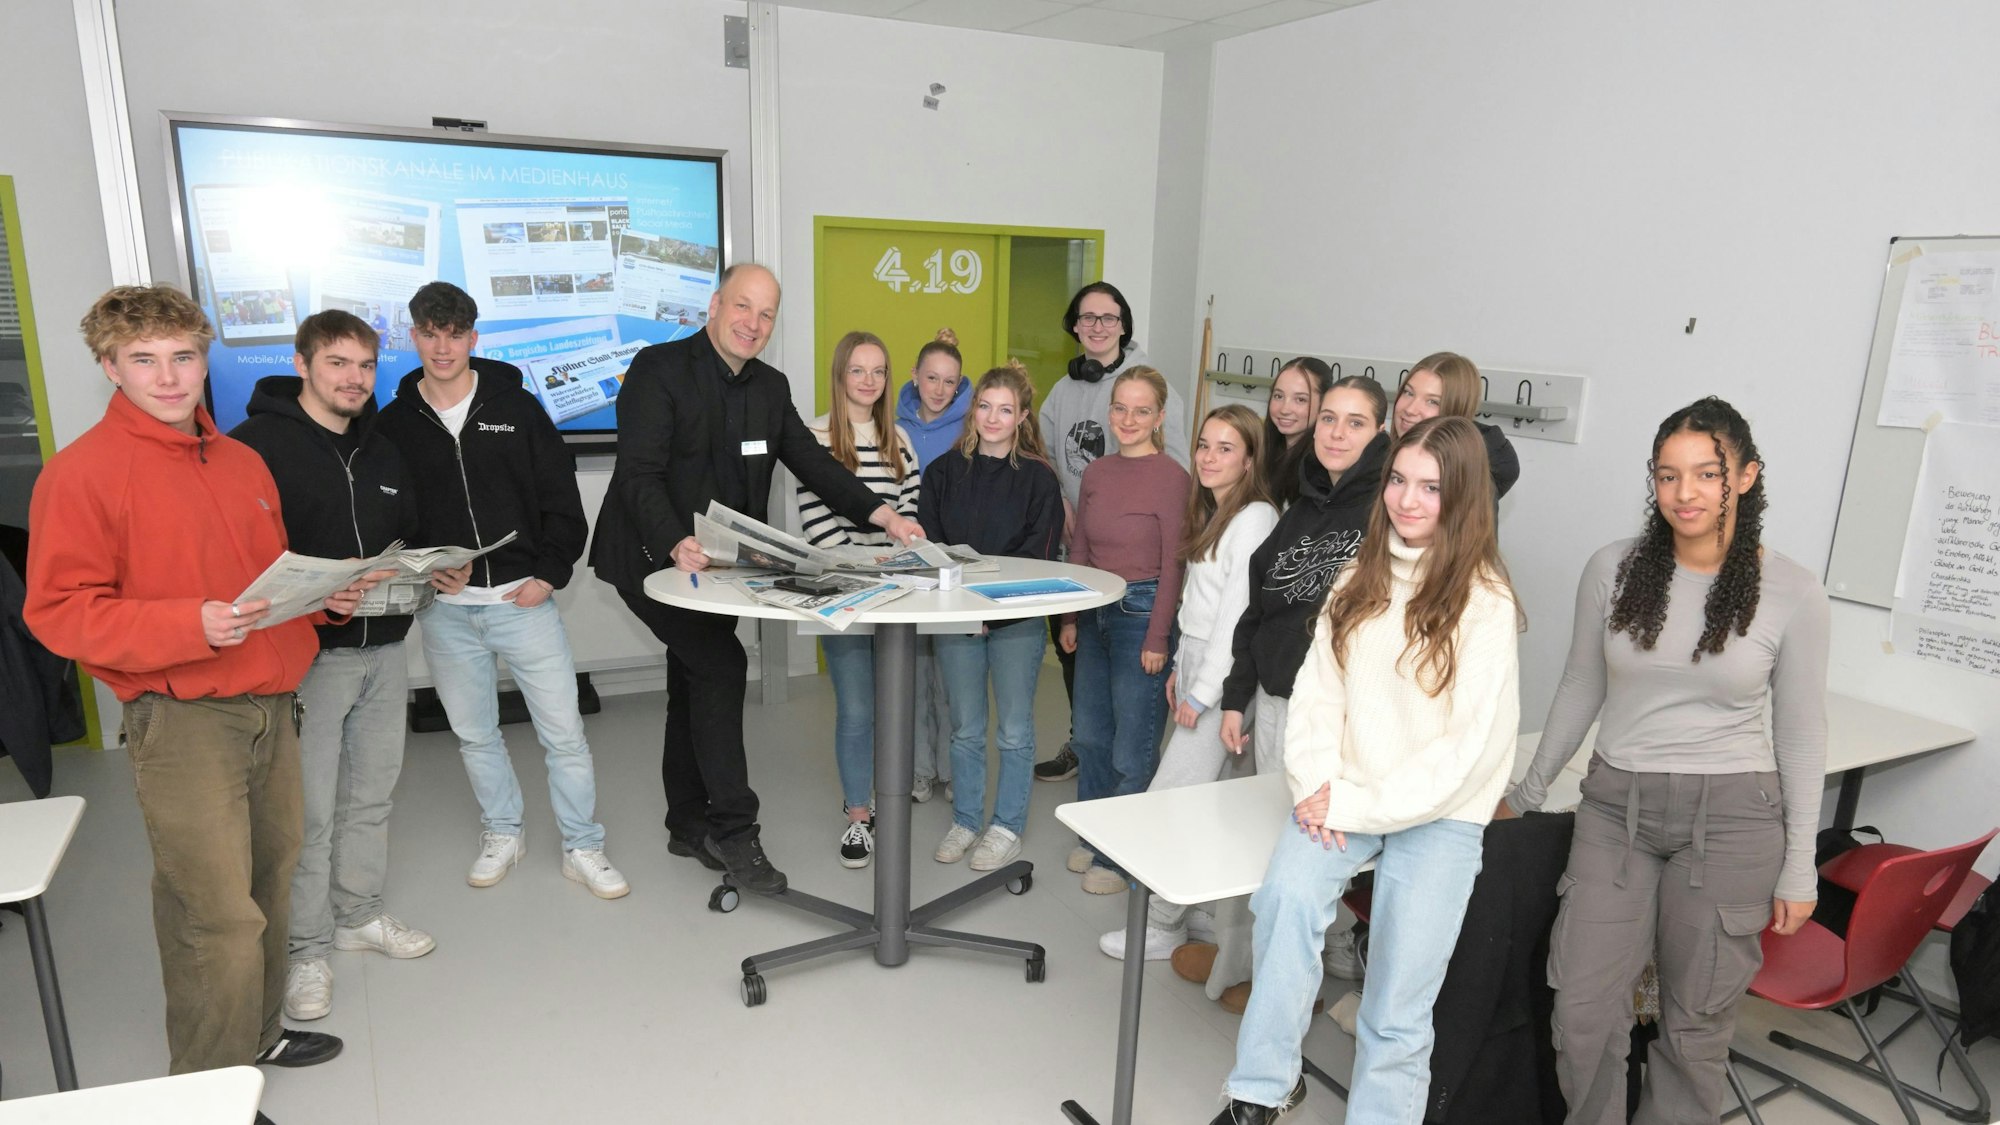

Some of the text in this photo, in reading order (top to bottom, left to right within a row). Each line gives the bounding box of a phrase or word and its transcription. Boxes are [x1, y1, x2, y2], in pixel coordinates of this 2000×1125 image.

[470, 164, 495, 182] IM
[501, 166, 628, 190] MEDIENHAUS
[610, 208, 628, 217] porta
[873, 246, 983, 294] 4.19
[237, 354, 295, 366] Mobile/Ap
[1947, 485, 1991, 508] Bewegung
